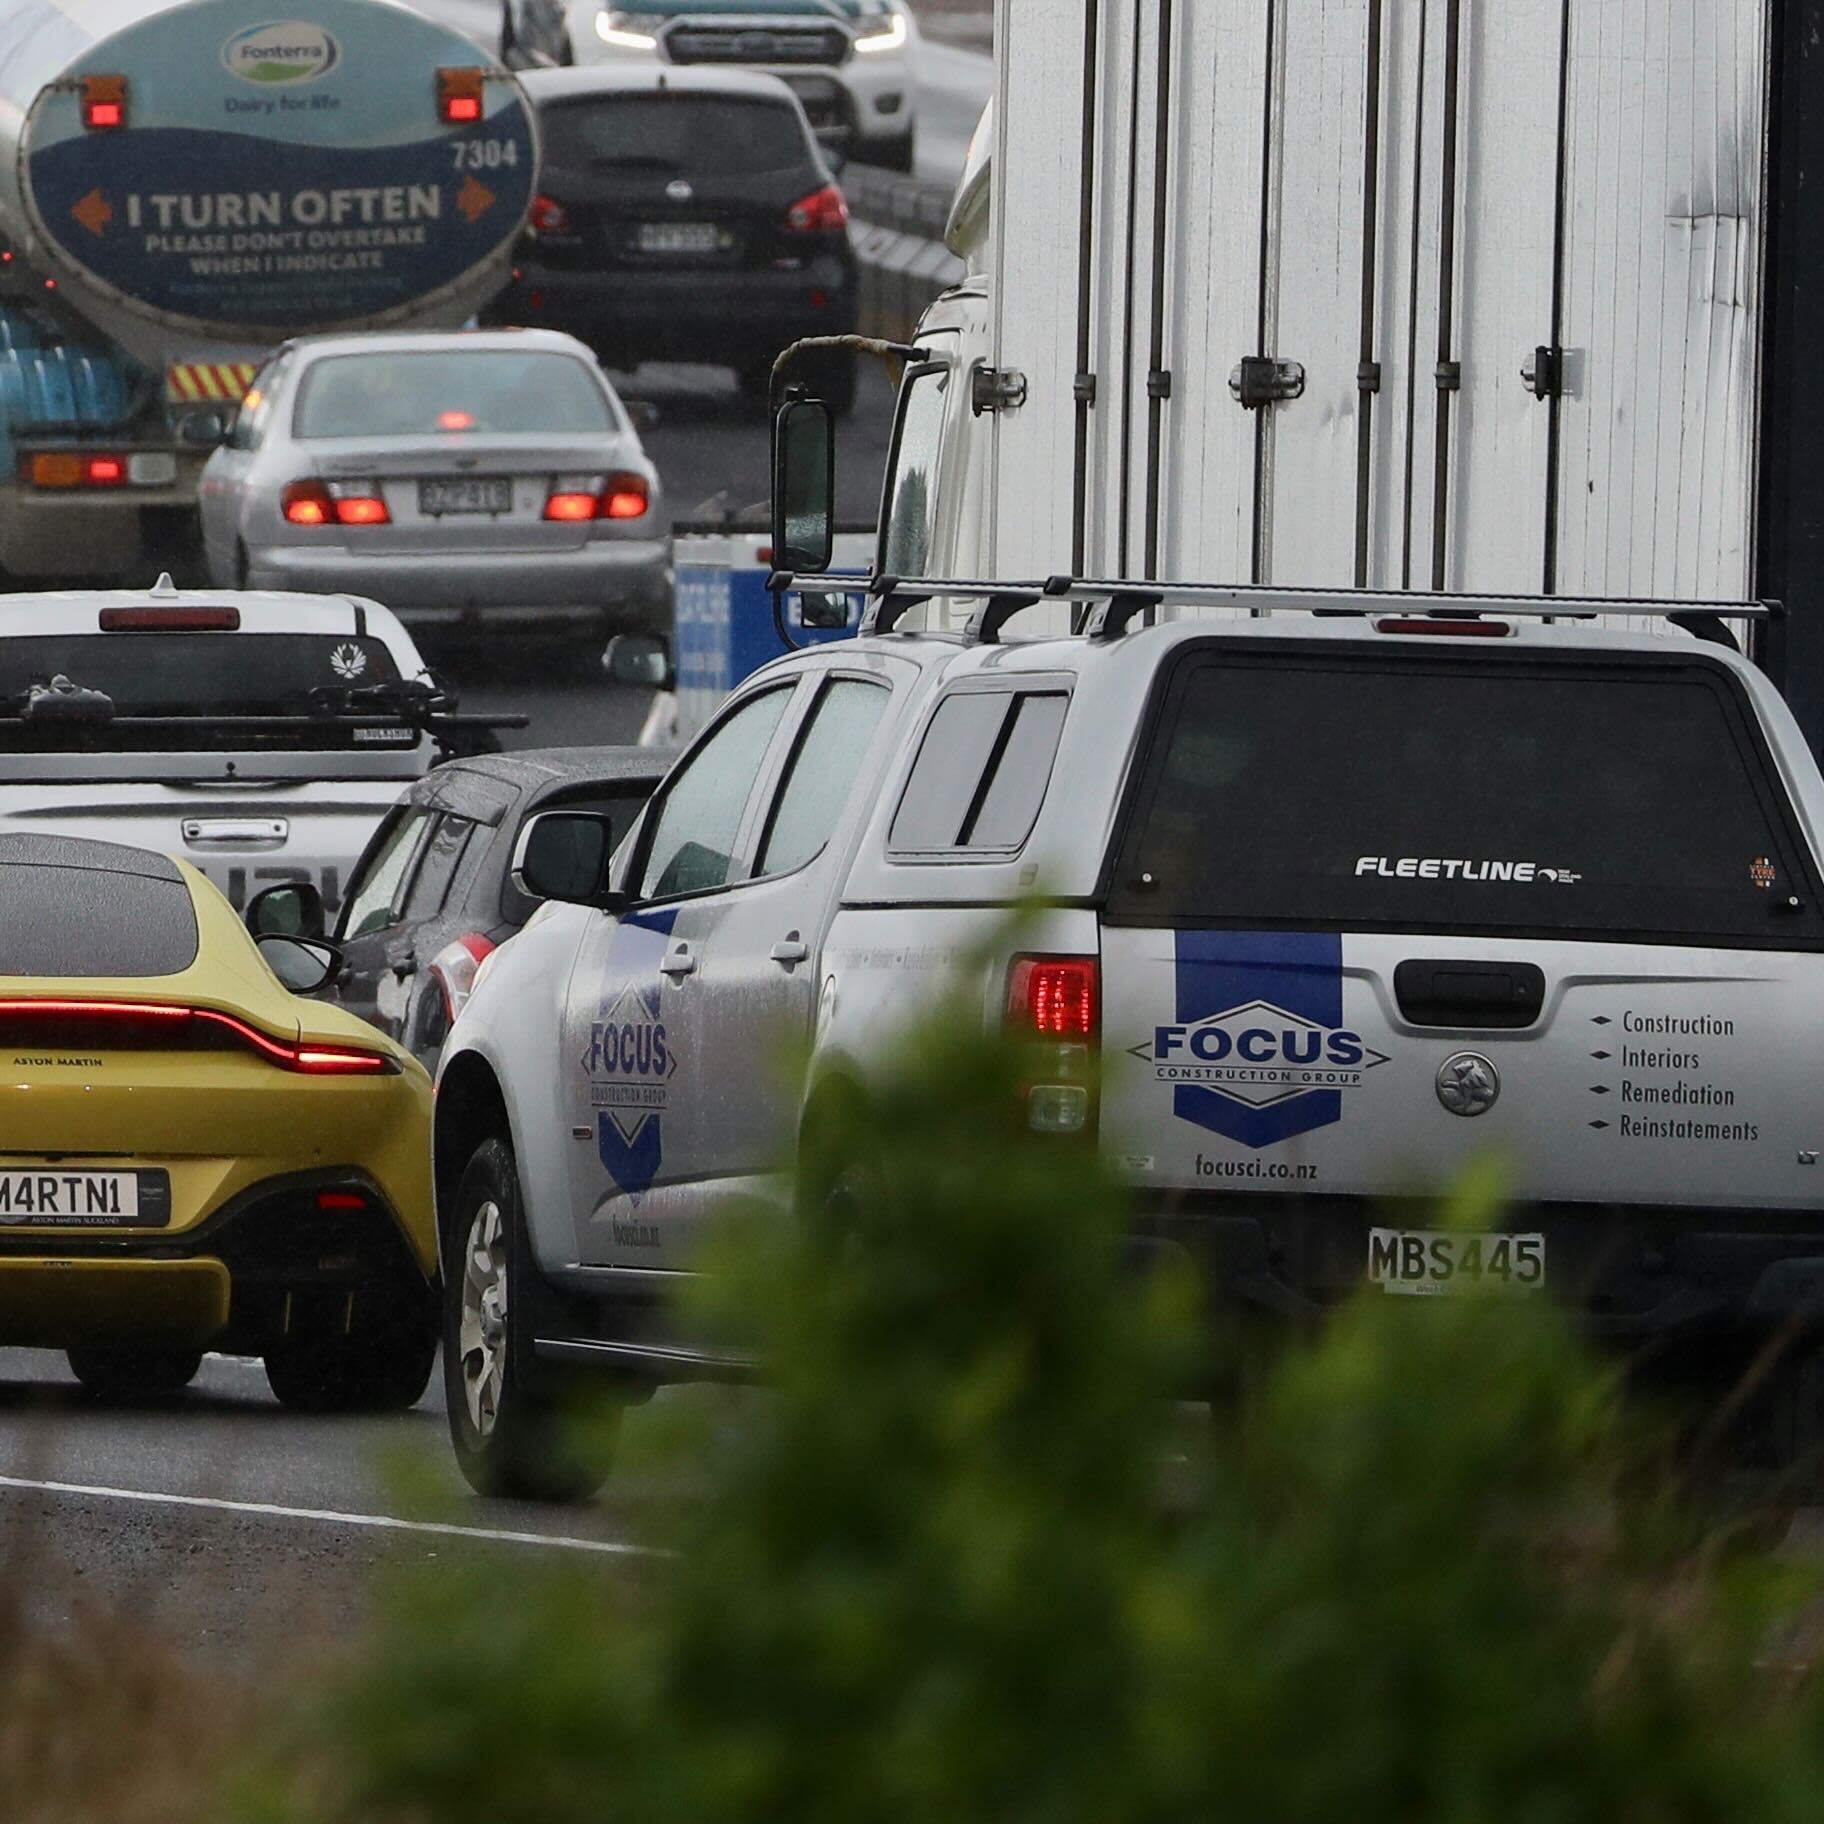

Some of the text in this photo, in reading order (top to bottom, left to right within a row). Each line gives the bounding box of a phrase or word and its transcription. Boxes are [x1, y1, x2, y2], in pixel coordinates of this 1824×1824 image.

[241, 42, 322, 60] Fonterra
[225, 95, 274, 114] Dairy
[453, 138, 517, 169] 7304
[125, 183, 443, 228] I TURN OFTEN
[146, 231, 227, 253] PLEASE
[307, 225, 427, 247] OVERTAKE
[190, 255, 261, 276] WHEN
[276, 251, 385, 273] INDICATE
[1355, 856, 1535, 882] FLEETLINE
[1623, 1010, 1734, 1036] Construction
[591, 1022, 667, 1075] FOCUS
[1154, 1026, 1363, 1067] FOCUS
[1622, 1045, 1700, 1069] Interiors
[13, 1056, 103, 1067] ASTON MARTIN
[1156, 1068, 1361, 1086] CONSTRUCTION GROUP
[1622, 1080, 1734, 1105] Remediation
[1621, 1114, 1759, 1140] Reinstatements
[1194, 1152, 1317, 1180] focusci.co.nz
[1371, 1231, 1544, 1278] MBS445
